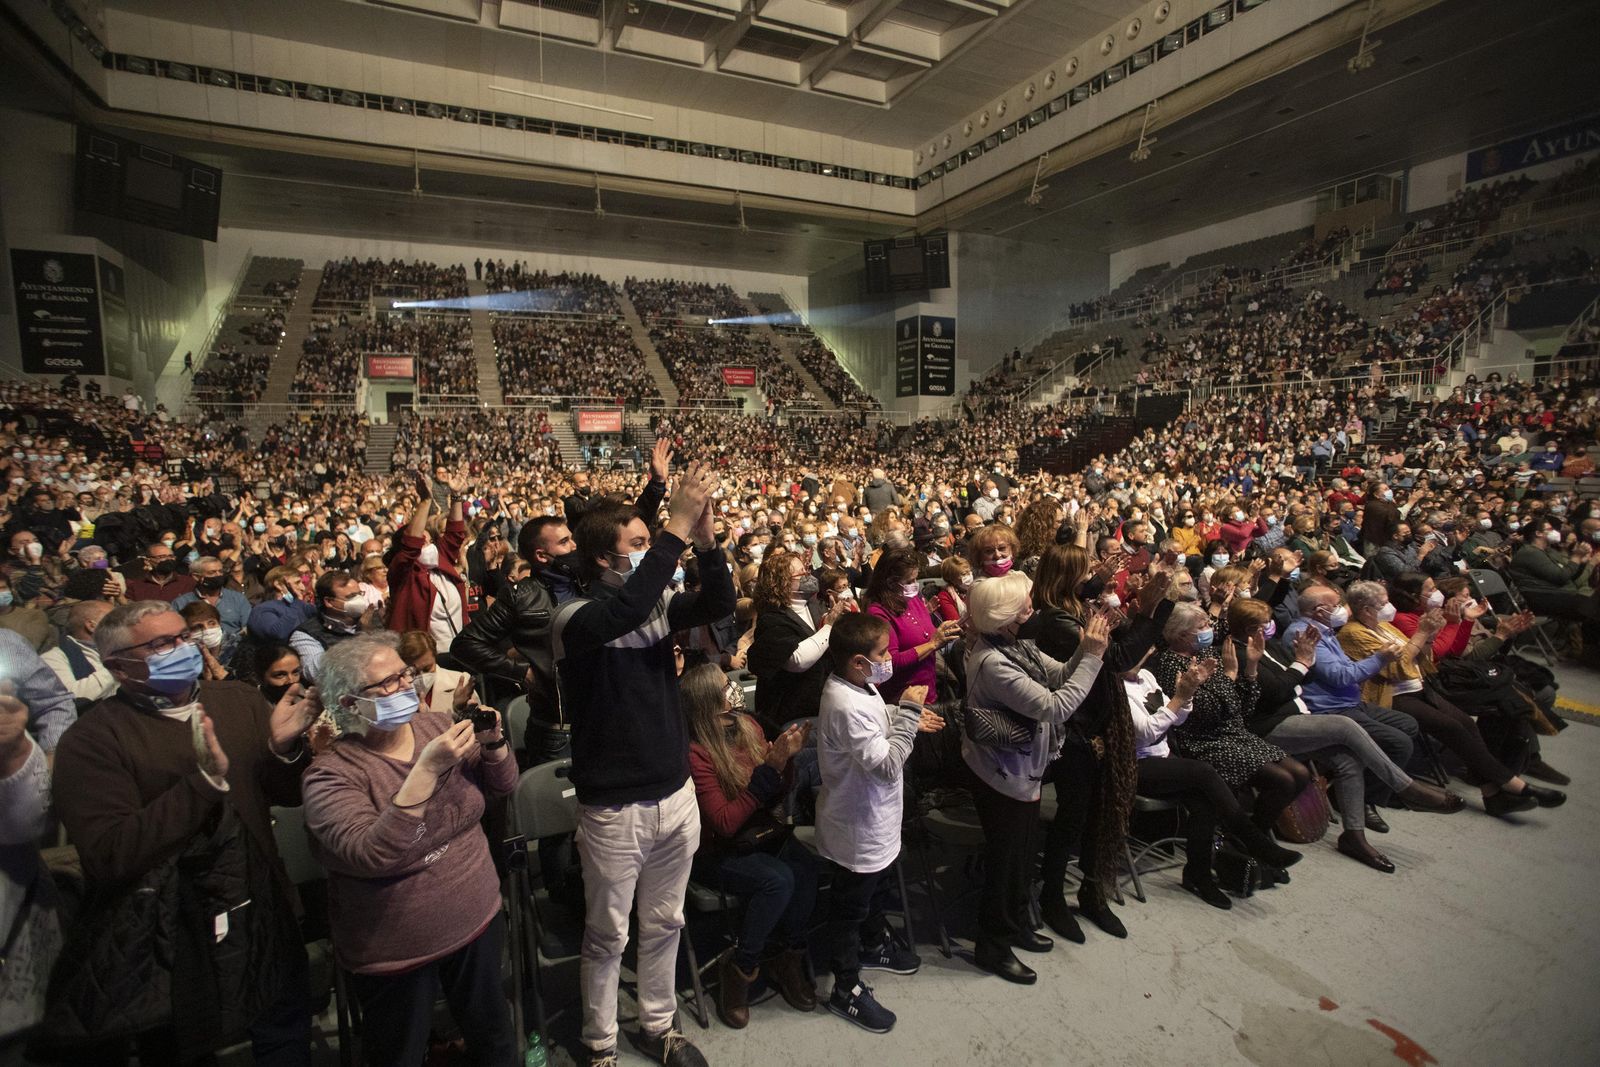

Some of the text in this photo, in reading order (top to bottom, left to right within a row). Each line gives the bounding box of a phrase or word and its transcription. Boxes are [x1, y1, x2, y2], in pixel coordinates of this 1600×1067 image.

[20, 282, 94, 294] AYUNTAMIENTO
[41, 292, 89, 303] GRANADA
[1425, 387, 1432, 395] A
